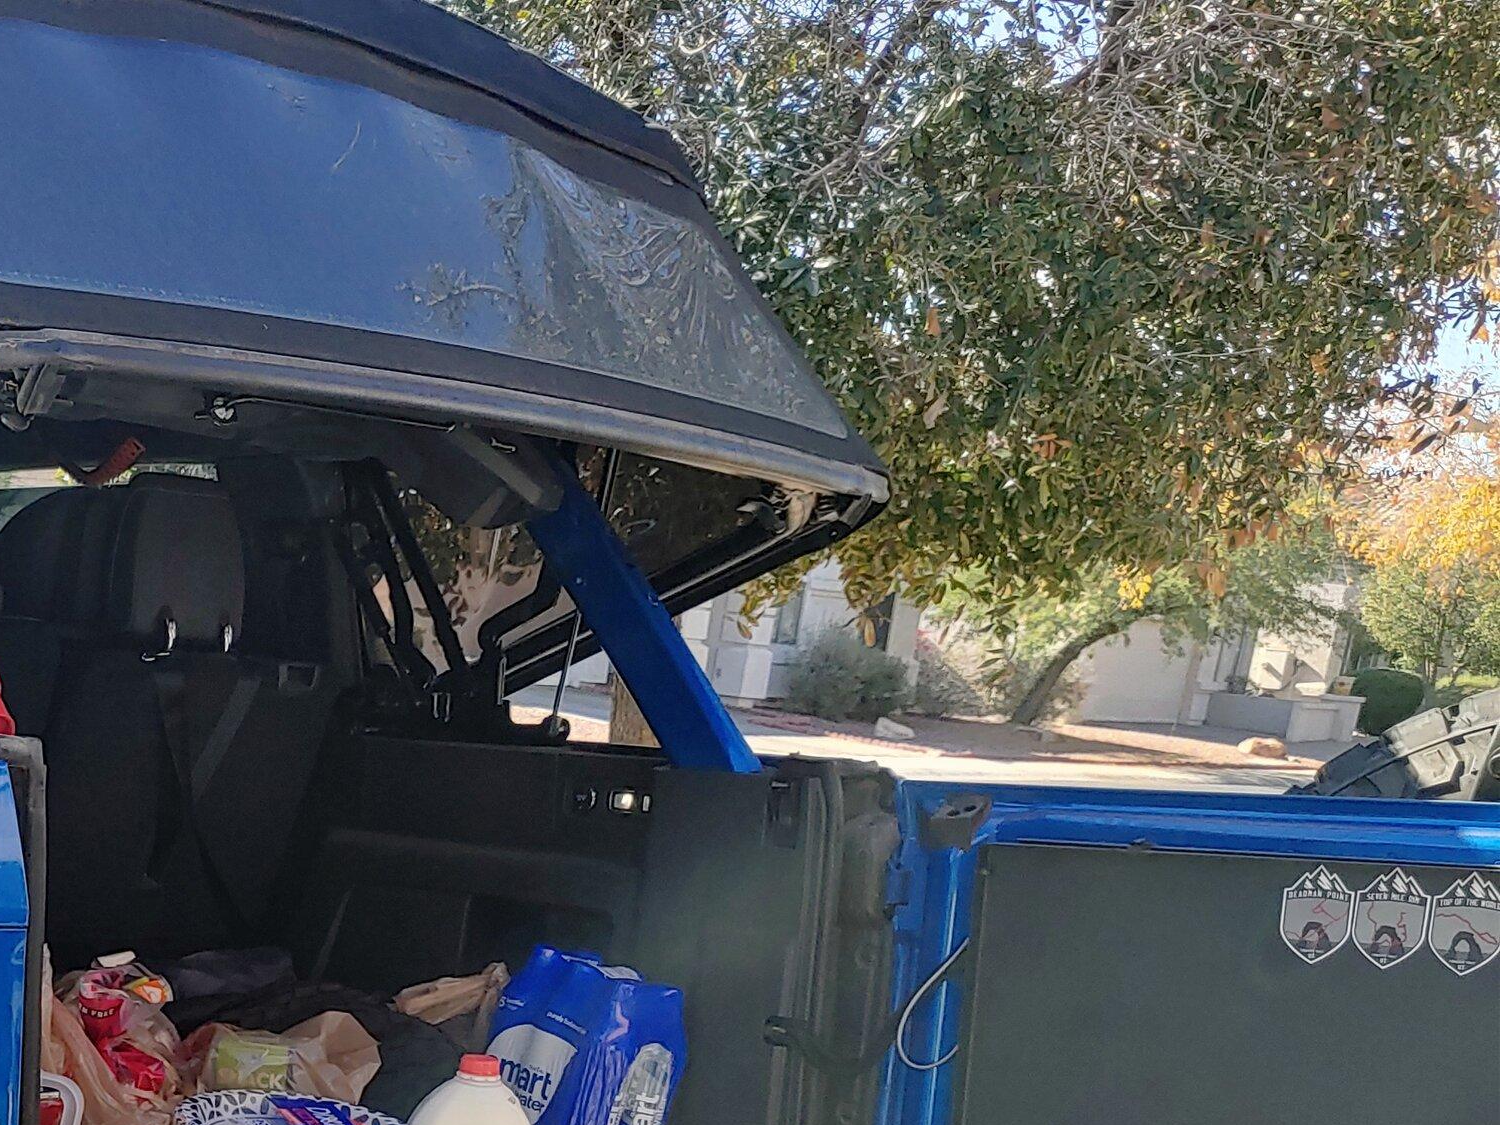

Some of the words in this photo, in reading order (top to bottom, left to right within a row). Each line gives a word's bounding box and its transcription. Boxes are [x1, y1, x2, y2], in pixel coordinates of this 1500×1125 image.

[1288, 889, 1322, 898] DEADMAN
[1326, 892, 1349, 901] POINT
[1366, 892, 1388, 900] SEVEN
[1439, 898, 1454, 906] TOP
[1454, 898, 1464, 906] OF
[1466, 898, 1479, 907] THE
[499, 1058, 552, 1101] mart
